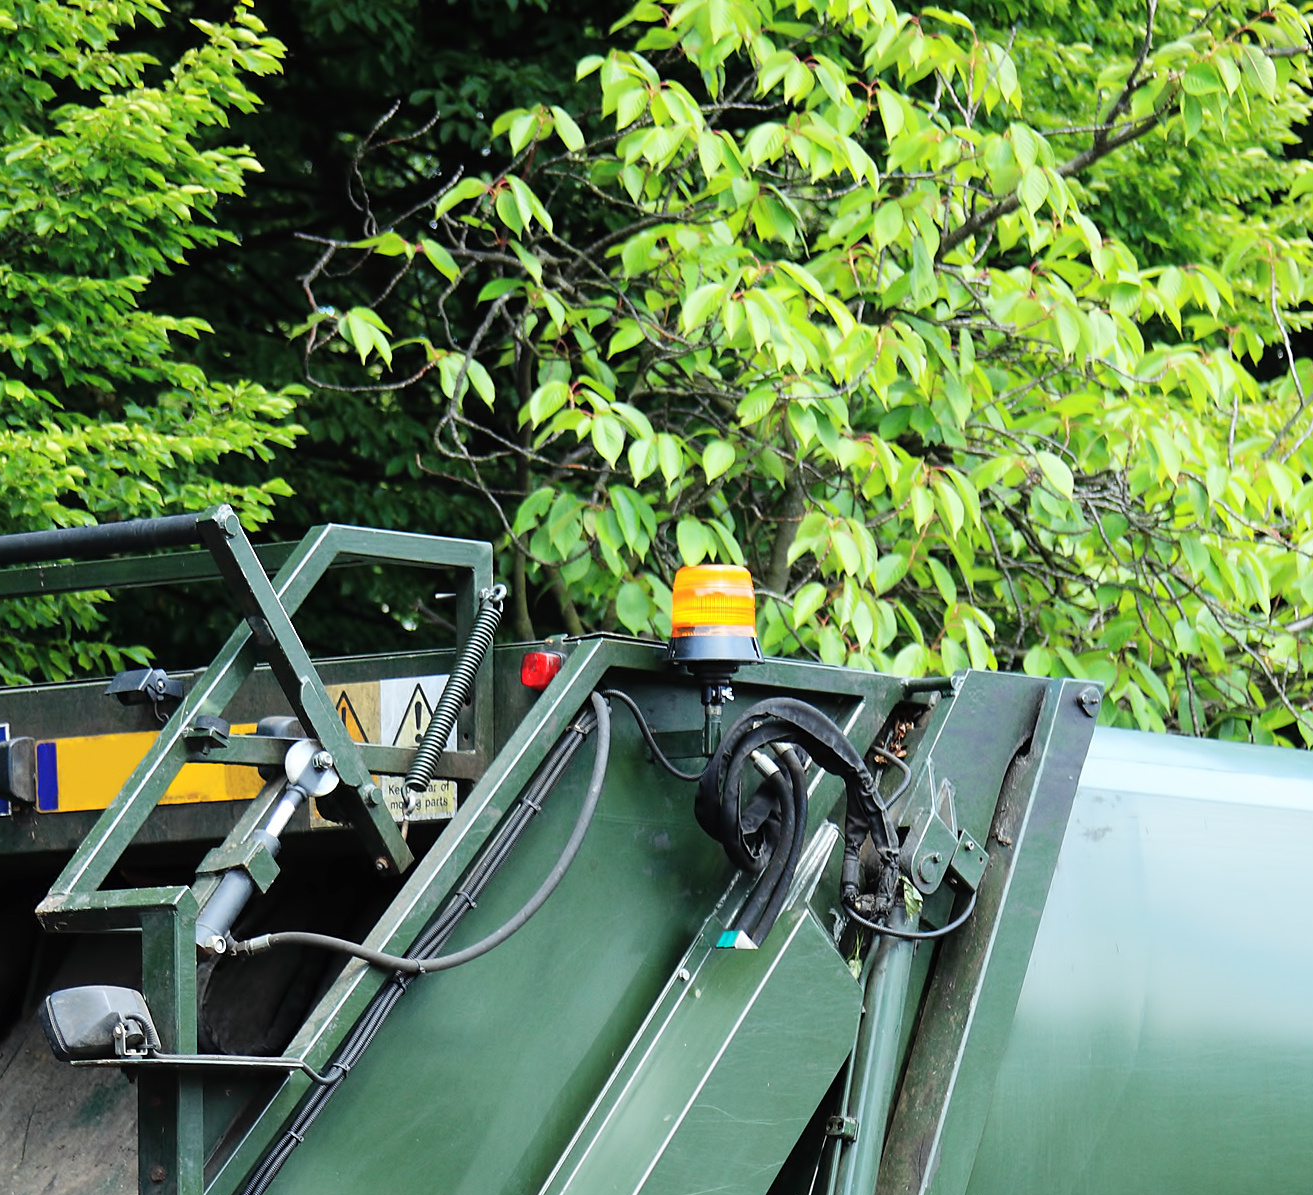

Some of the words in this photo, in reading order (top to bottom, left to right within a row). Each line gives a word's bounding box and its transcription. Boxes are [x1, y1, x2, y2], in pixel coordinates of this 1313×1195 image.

[388, 784, 411, 795] Kep
[390, 801, 421, 811] mog
[425, 796, 448, 809] parts
